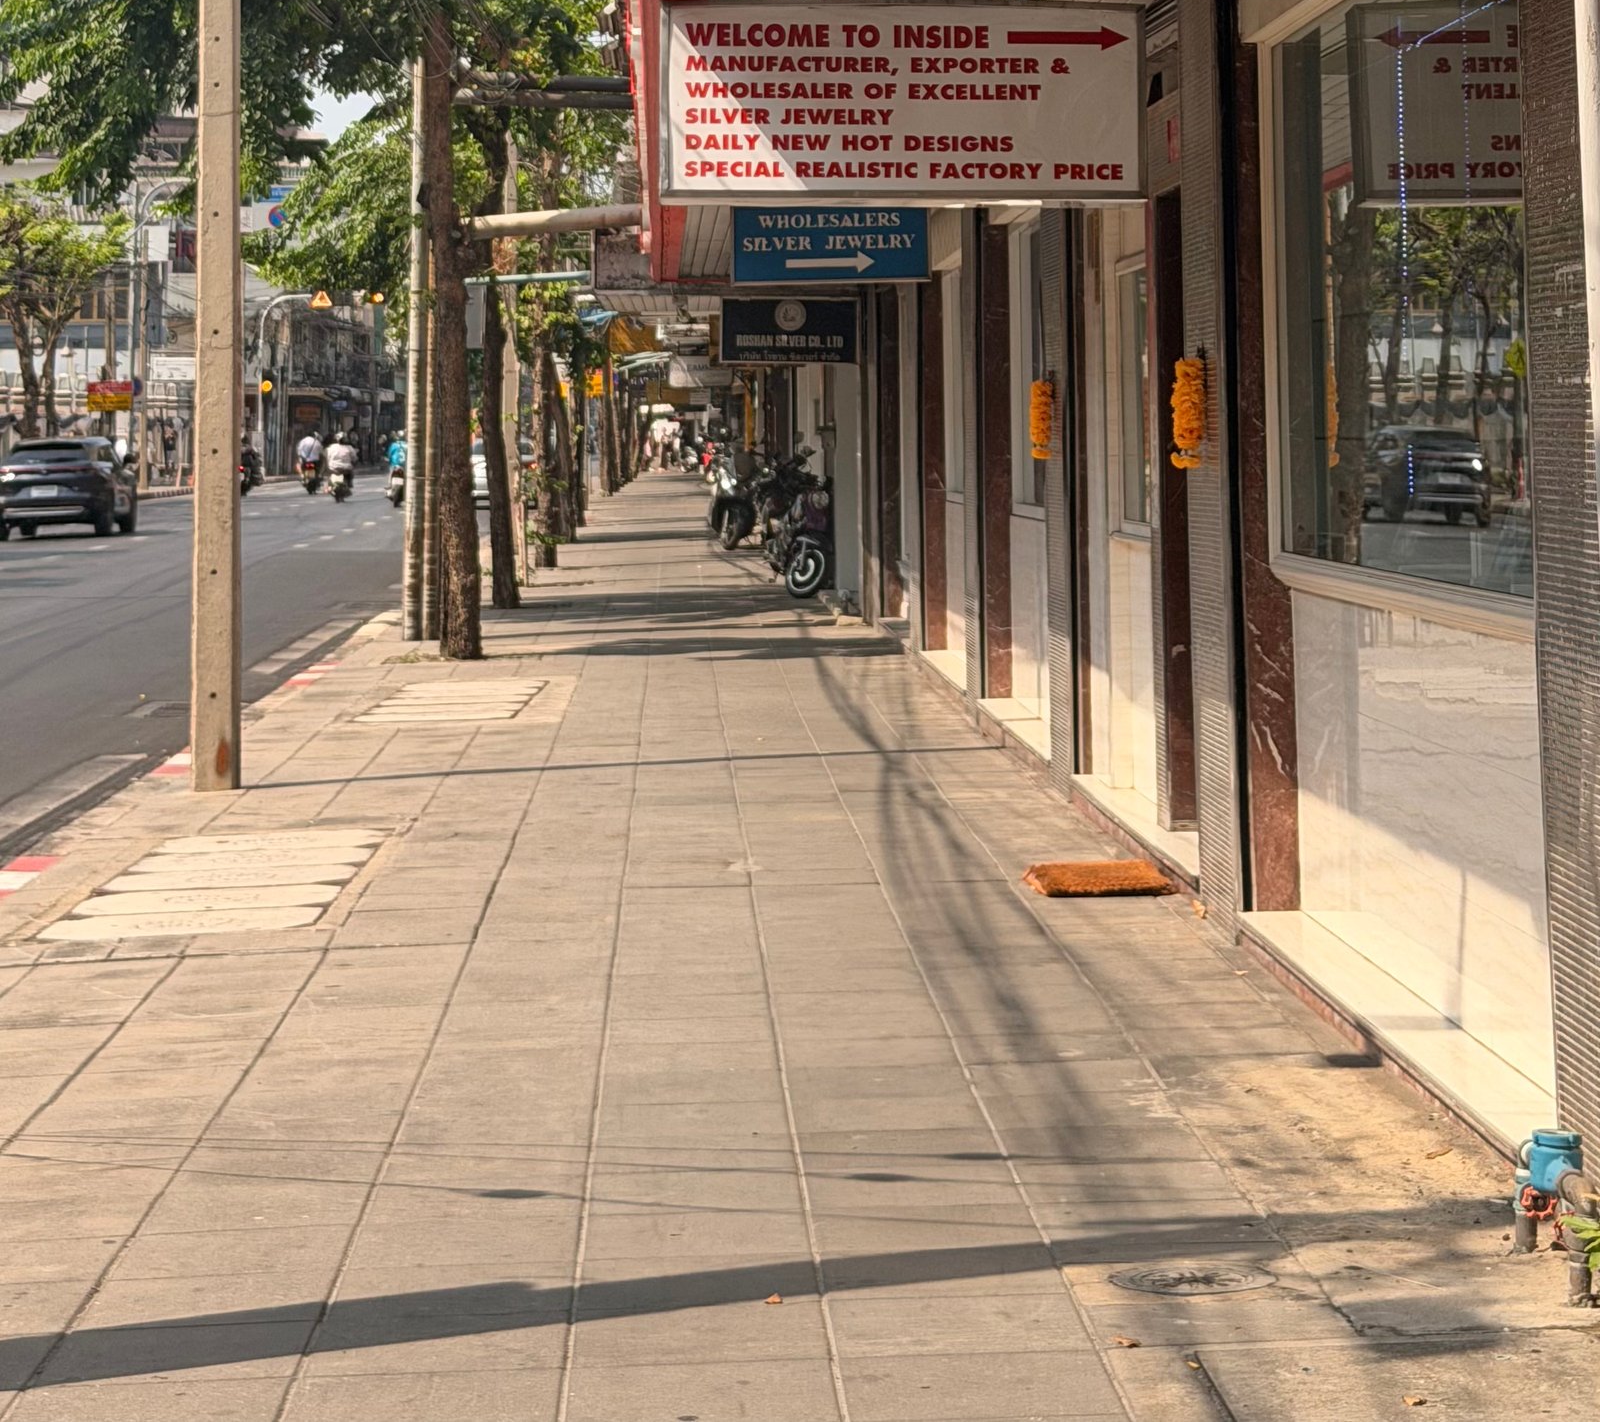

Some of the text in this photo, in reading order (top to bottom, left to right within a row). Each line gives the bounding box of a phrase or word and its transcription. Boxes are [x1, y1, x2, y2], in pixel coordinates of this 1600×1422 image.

[685, 22, 990, 50] WELCOME TO INSIDE
[684, 55, 1071, 76] MANUFACTURER, EXPORTER &
[684, 81, 1042, 101] WHOLESALER OF EXCELLENT
[683, 107, 894, 126] SILVER JEWELRY
[683, 133, 1015, 153] DAILY NEW HOT DESIGNS
[683, 160, 1124, 181] SPECIAL REALISTIC FACTORY PRICE
[758, 212, 901, 229] WHOLESALERS
[742, 233, 916, 252] SILVER JEWELRY
[736, 334, 773, 347] ROSHAN
[775, 334, 807, 347] SILVER
